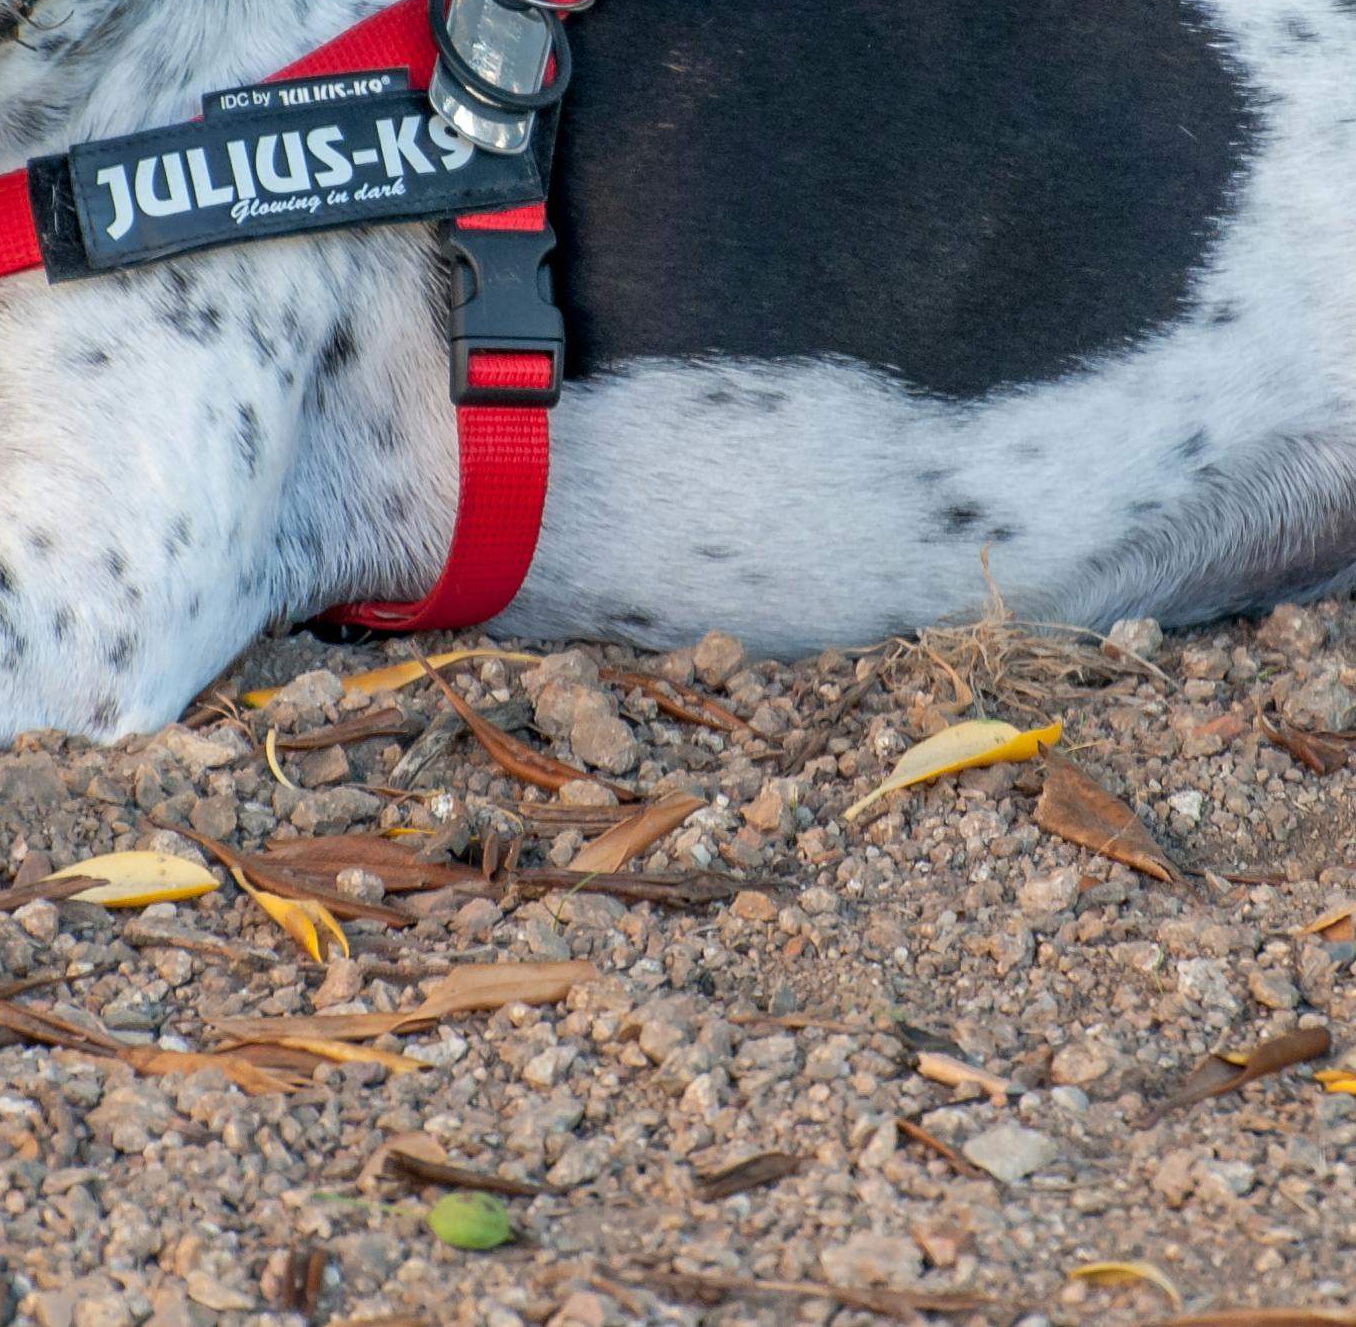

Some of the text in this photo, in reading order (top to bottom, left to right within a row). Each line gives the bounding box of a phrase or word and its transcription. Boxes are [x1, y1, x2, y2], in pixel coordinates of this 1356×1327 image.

[220, 94, 249, 111] IDC
[252, 90, 271, 107] by
[97, 114, 474, 241] JULIUS-K9
[230, 177, 407, 225] Glowing in dark
